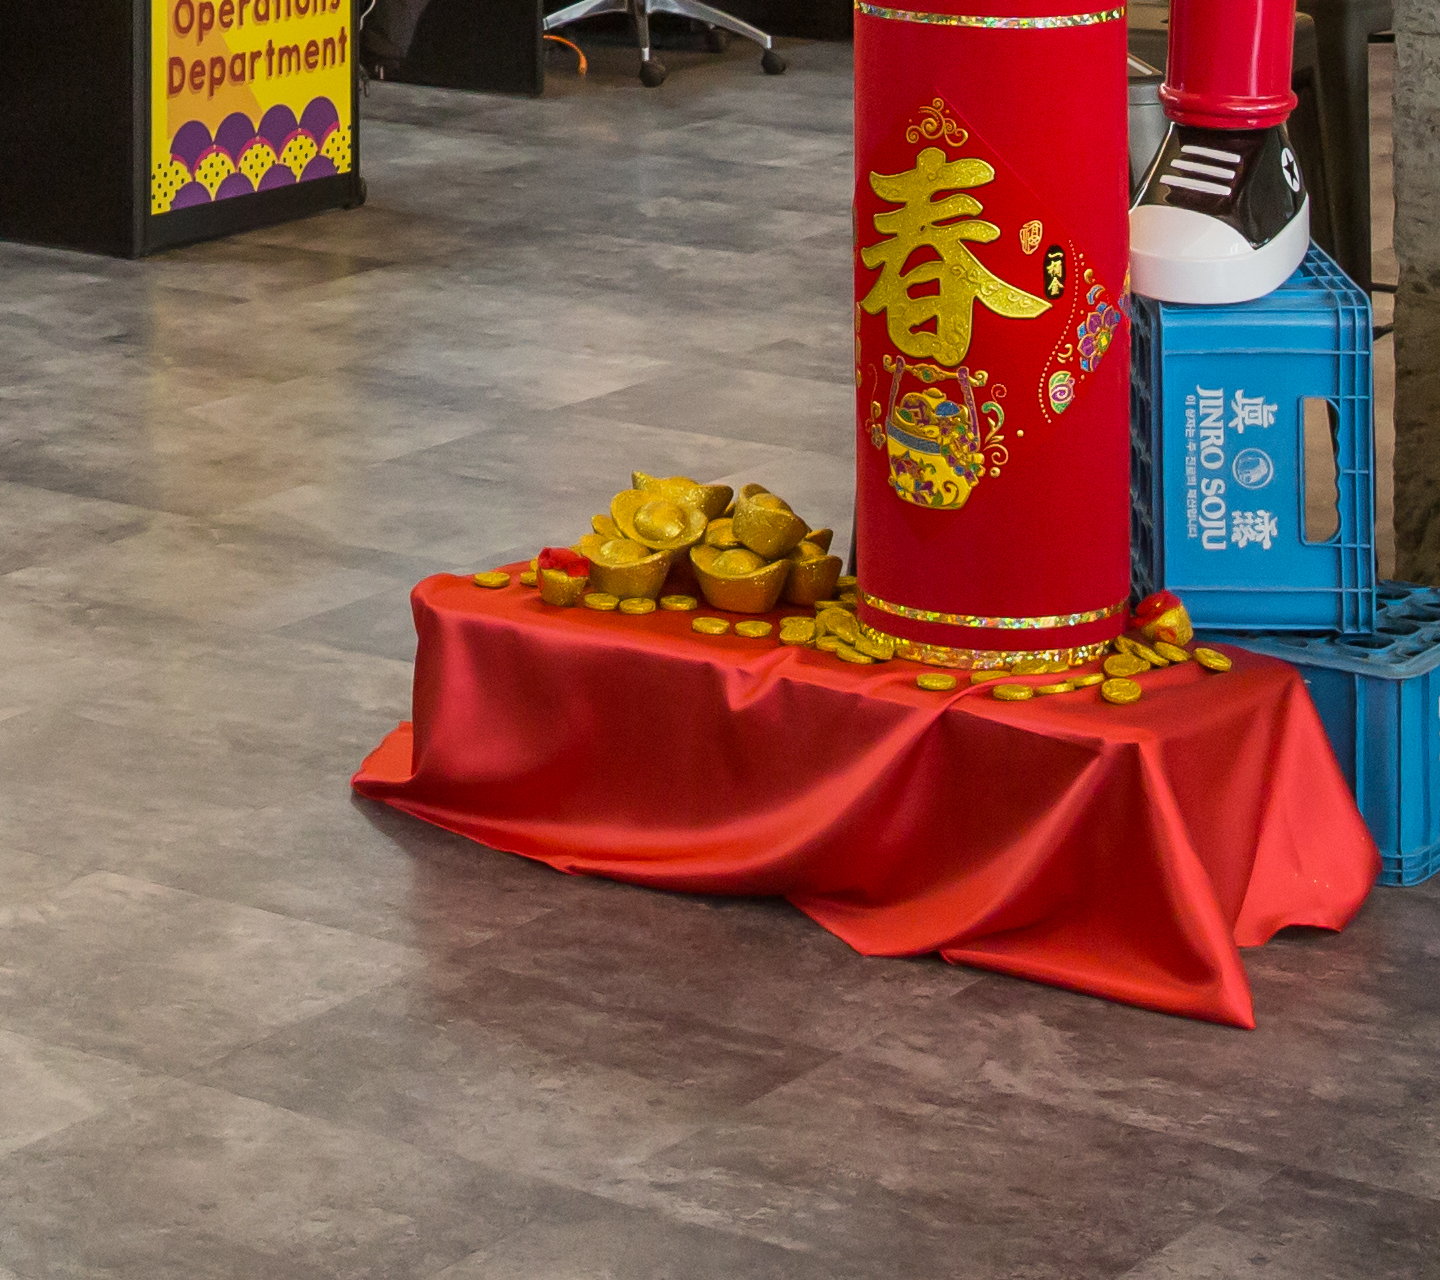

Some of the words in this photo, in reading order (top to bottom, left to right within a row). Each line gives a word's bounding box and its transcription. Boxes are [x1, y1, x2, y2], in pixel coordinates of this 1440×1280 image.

[167, 25, 348, 99] Department
[860, 146, 1053, 366] 春
[1196, 384, 1226, 471] JINRO
[1198, 477, 1227, 551] SOJU
